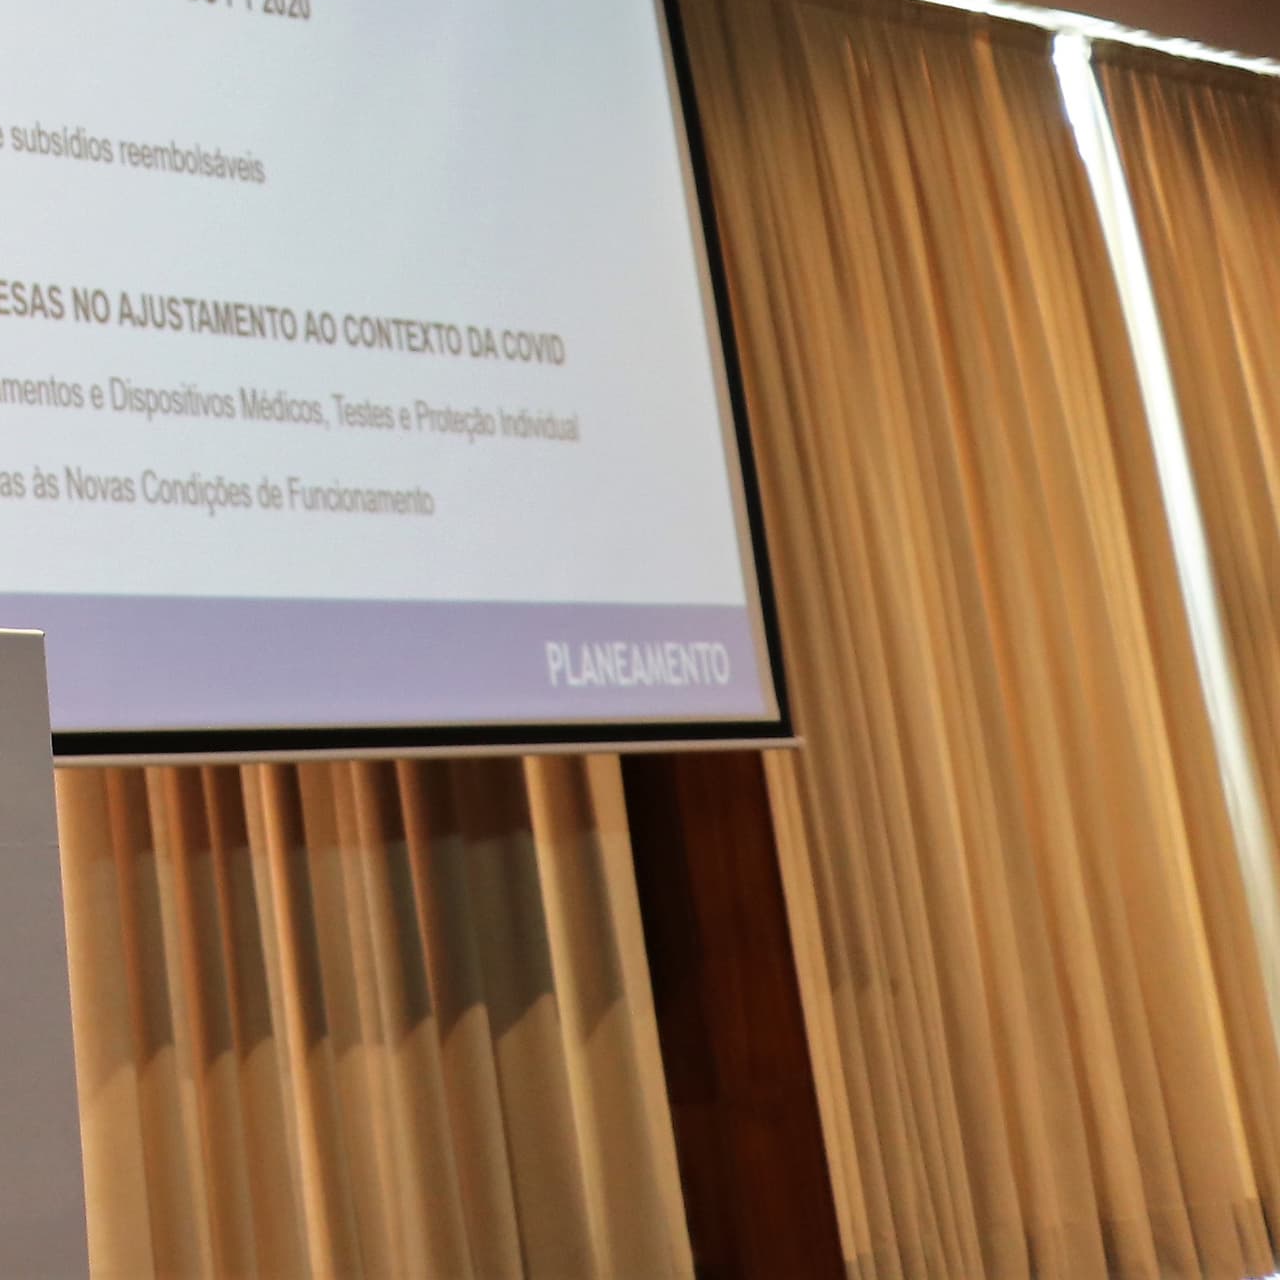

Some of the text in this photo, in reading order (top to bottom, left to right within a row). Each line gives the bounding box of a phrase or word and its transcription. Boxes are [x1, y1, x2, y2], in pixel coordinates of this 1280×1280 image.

[11, 119, 114, 164] subsídios
[119, 140, 266, 184] reembolsáveis
[72, 286, 110, 326] NO
[118, 291, 298, 342] AJUSTAMENTO
[304, 311, 337, 346] AO
[342, 313, 462, 356] CONTEXTO
[467, 326, 499, 361] DA
[503, 329, 566, 367] COVID
[91, 383, 104, 406] e
[110, 378, 236, 419] Dispositivos
[239, 387, 329, 432] Médicos,
[331, 394, 396, 431] Testes
[399, 407, 412, 429] e
[414, 400, 497, 444] Proteção
[32, 465, 60, 499] às
[65, 466, 136, 503] Novas
[142, 470, 252, 517] Condições
[257, 477, 284, 510] de
[288, 476, 435, 515] Funcionamento
[544, 640, 731, 688] PLANEAMENTO
